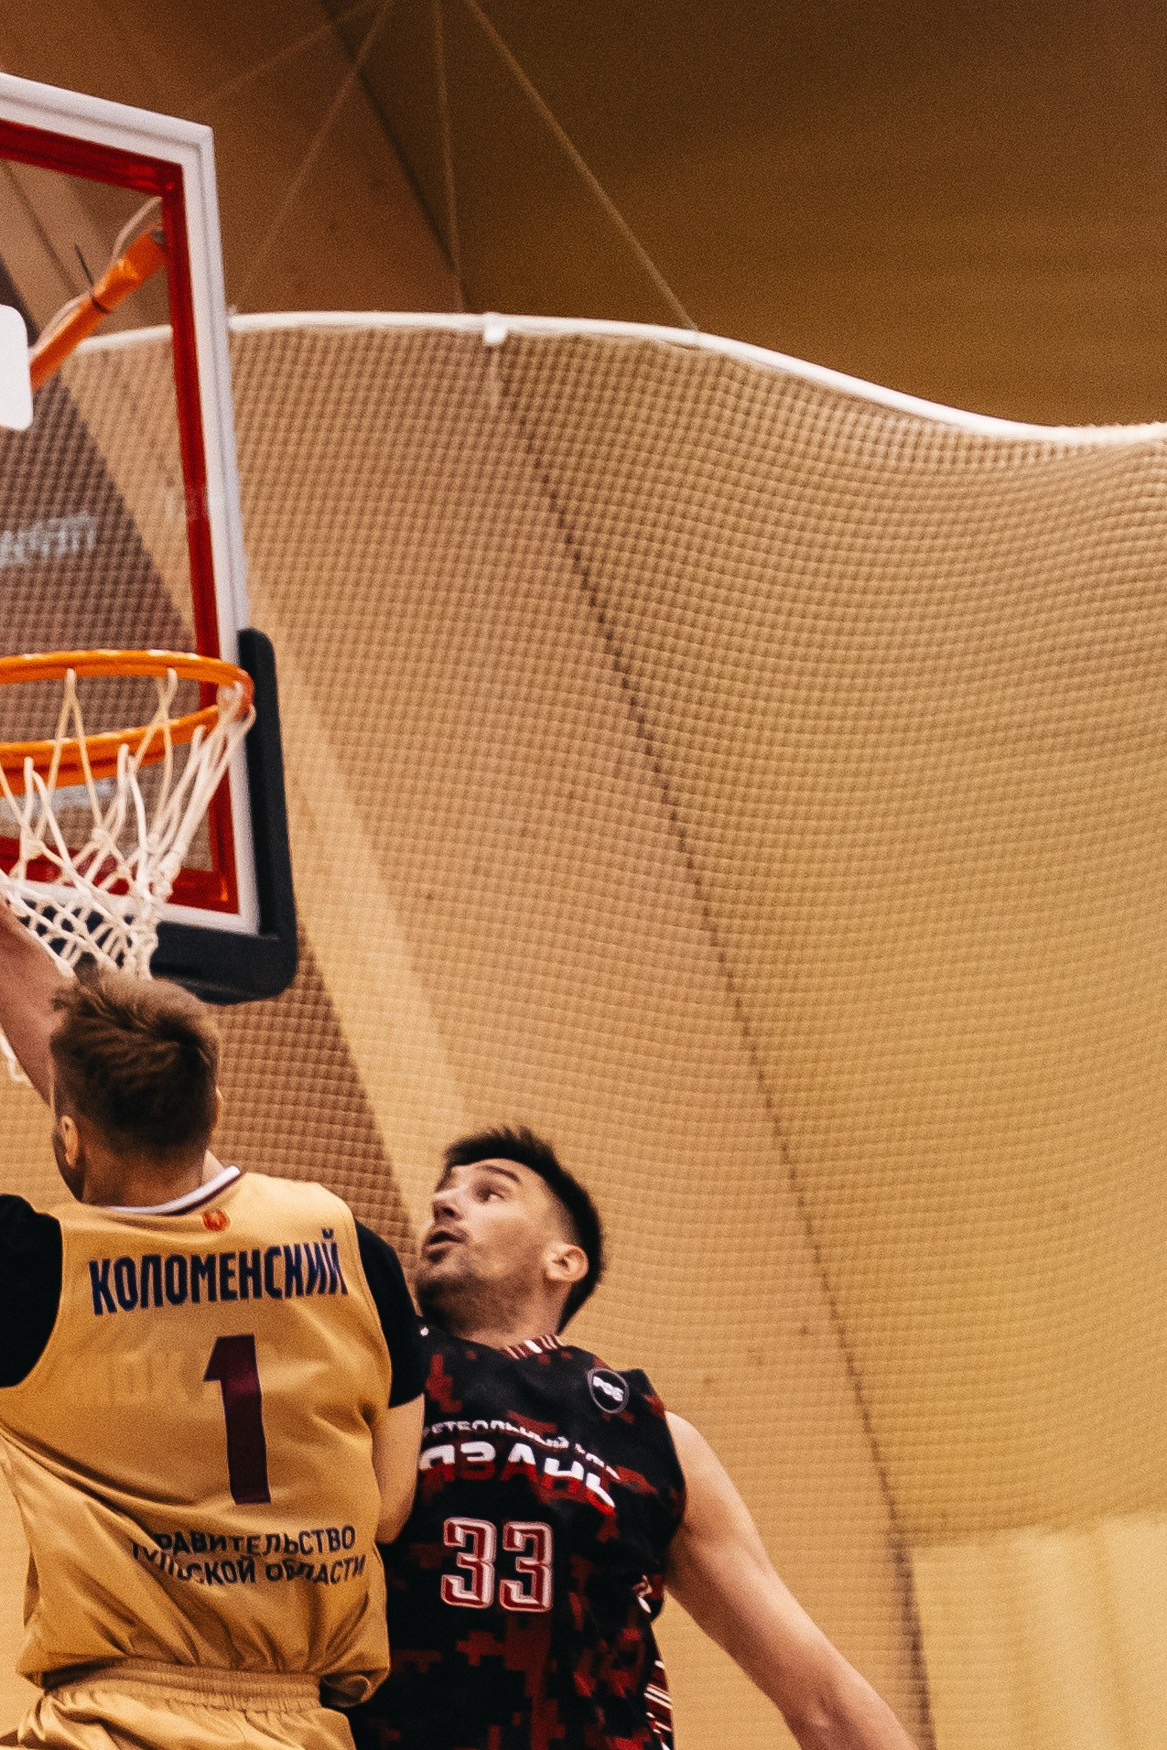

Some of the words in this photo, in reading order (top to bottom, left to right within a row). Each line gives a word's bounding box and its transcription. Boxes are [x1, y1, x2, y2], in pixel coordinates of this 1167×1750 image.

[88, 1227, 349, 1316] КОЛОМЕНСКИЙ
[203, 1333, 272, 1505] 1
[418, 1441, 617, 1516] ЯЗАНЬ
[153, 1525, 356, 1556] РАВИТЕЛЬСТВО
[440, 1516, 554, 1613] 33
